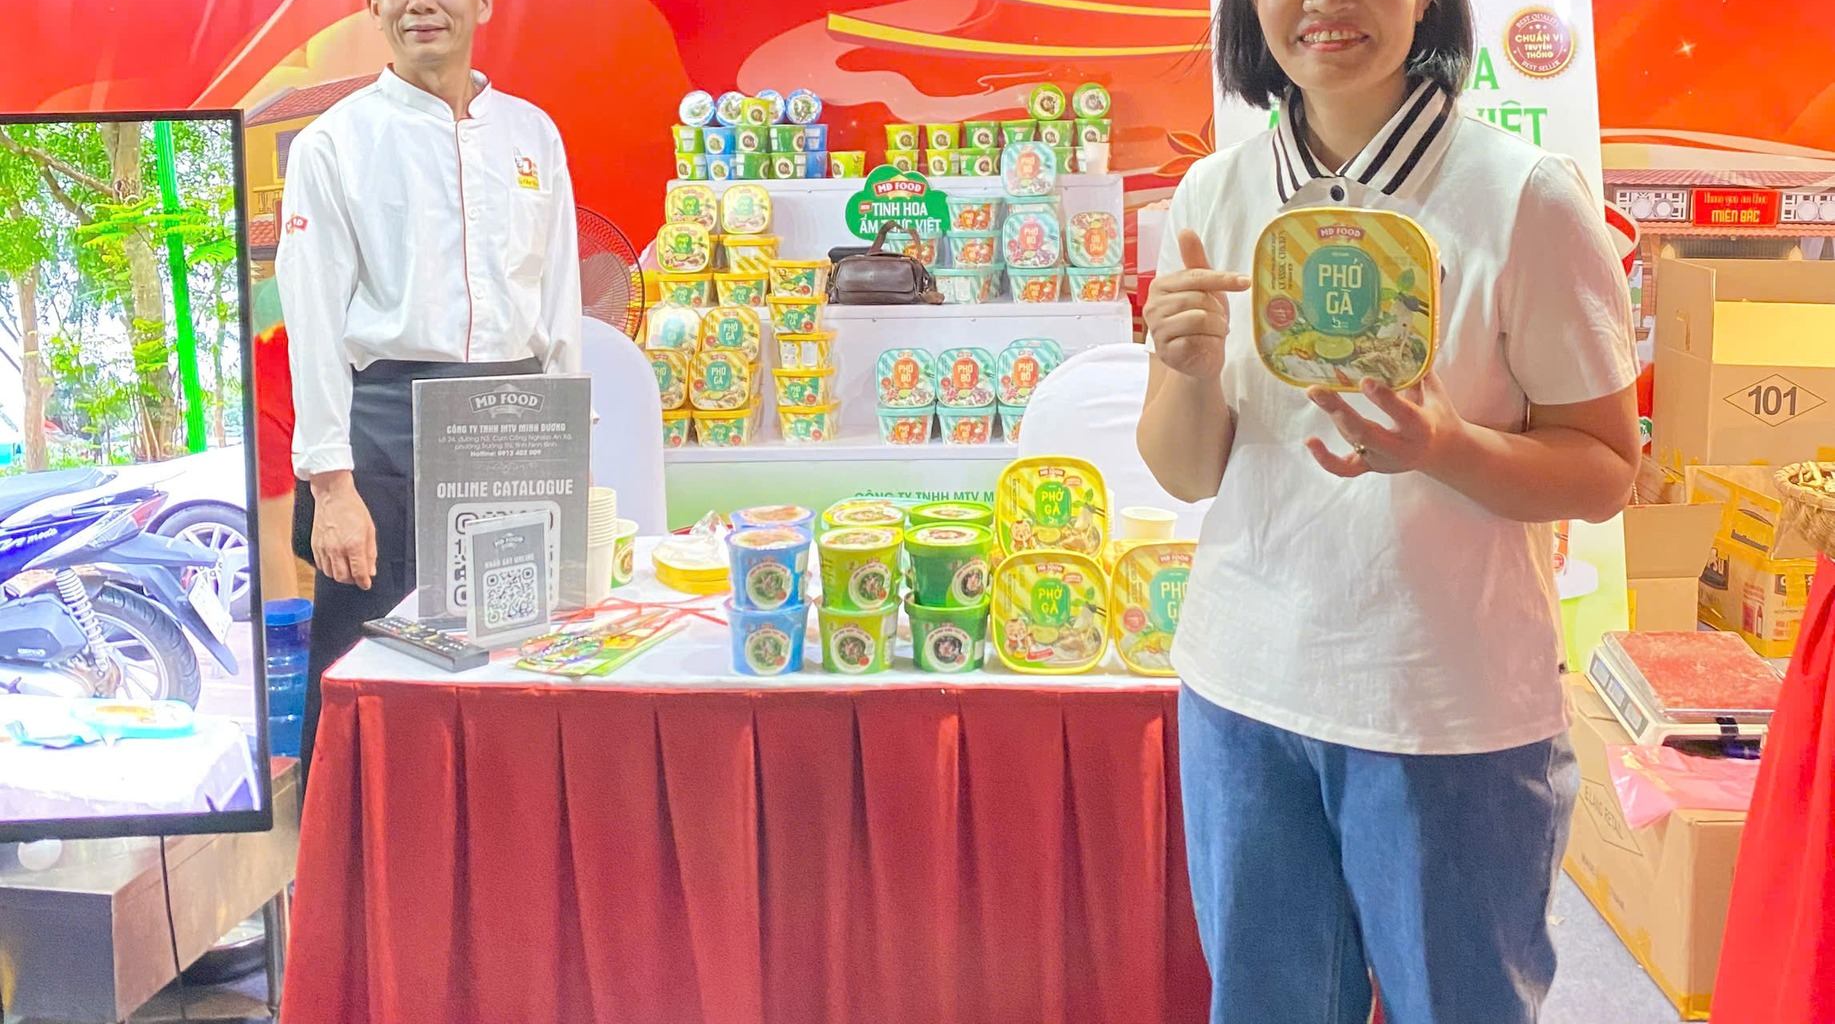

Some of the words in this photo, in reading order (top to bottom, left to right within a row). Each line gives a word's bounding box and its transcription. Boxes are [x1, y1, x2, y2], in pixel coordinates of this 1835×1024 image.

[895, 182, 922, 193] FOOD
[872, 202, 900, 216] TINH
[903, 202, 928, 216] HOA
[1318, 258, 1364, 288] PHỞ
[1326, 288, 1354, 315] GÀ
[474, 395, 497, 408] MD
[500, 393, 538, 407] FOOD
[1747, 385, 1797, 416] 101
[447, 424, 467, 434] CÔNG
[469, 424, 478, 433] TY
[437, 481, 488, 498] ONLINE
[493, 479, 574, 496] CATALOGUE
[1041, 489, 1064, 502] PHỞ
[1045, 502, 1060, 514] GÀ
[1039, 586, 1064, 600] PHỞ
[1041, 600, 1059, 614] GÀ
